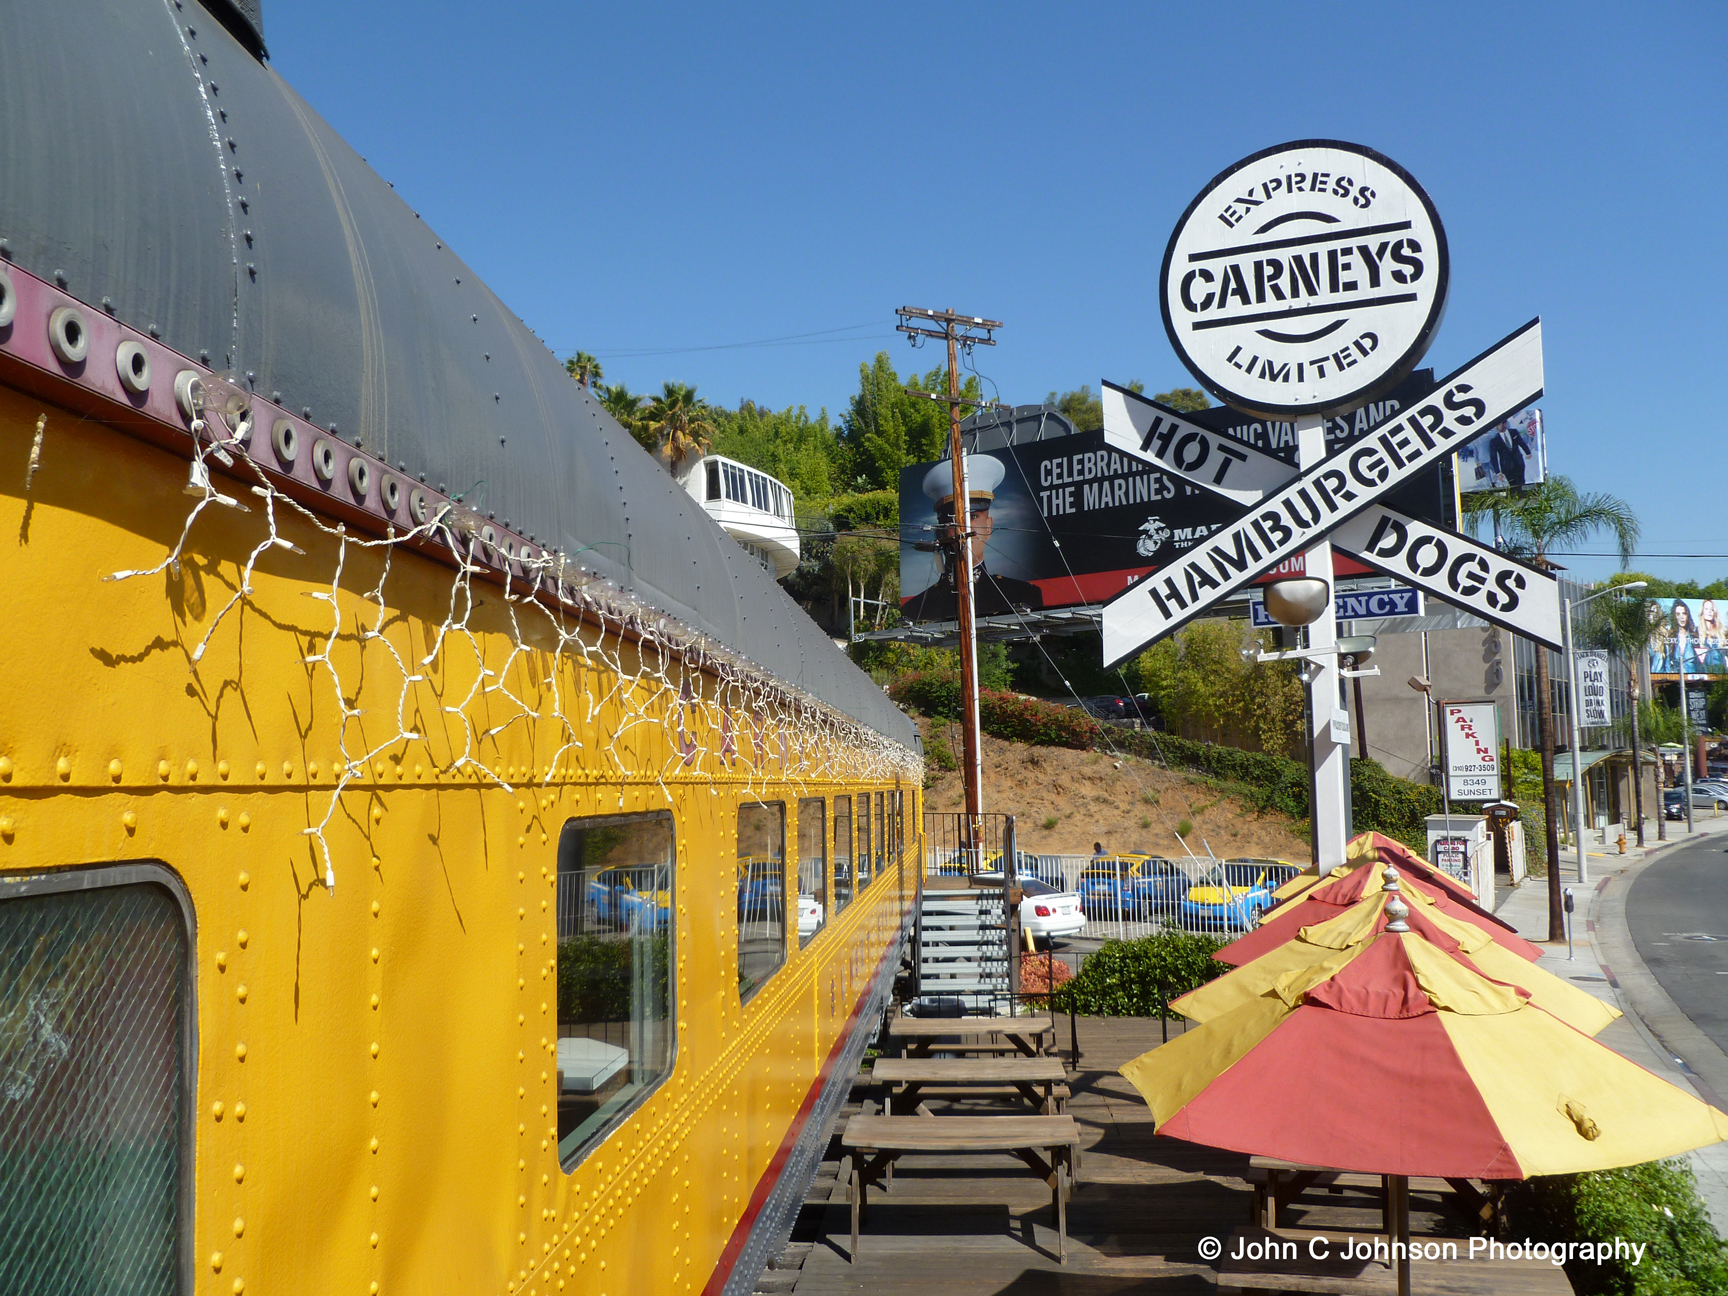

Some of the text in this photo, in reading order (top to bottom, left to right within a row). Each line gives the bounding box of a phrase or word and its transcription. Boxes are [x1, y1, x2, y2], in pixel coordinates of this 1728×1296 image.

[1217, 172, 1377, 229] EXPRESS
[1180, 238, 1424, 313] CARNEYS
[1226, 331, 1379, 383] LIMITED
[1040, 472, 1175, 517] THE MARINES
[1139, 416, 1527, 613] HOT DOGS
[1148, 383, 1487, 620] HAMBURGERS
[1584, 671, 1603, 682] PLAY
[1584, 685, 1604, 697] LOUD
[1449, 708, 1495, 762] PARKING
[1463, 778, 1487, 786] 8349
[1464, 764, 1495, 772] 927-3509
[1457, 788, 1493, 797] SUNSET
